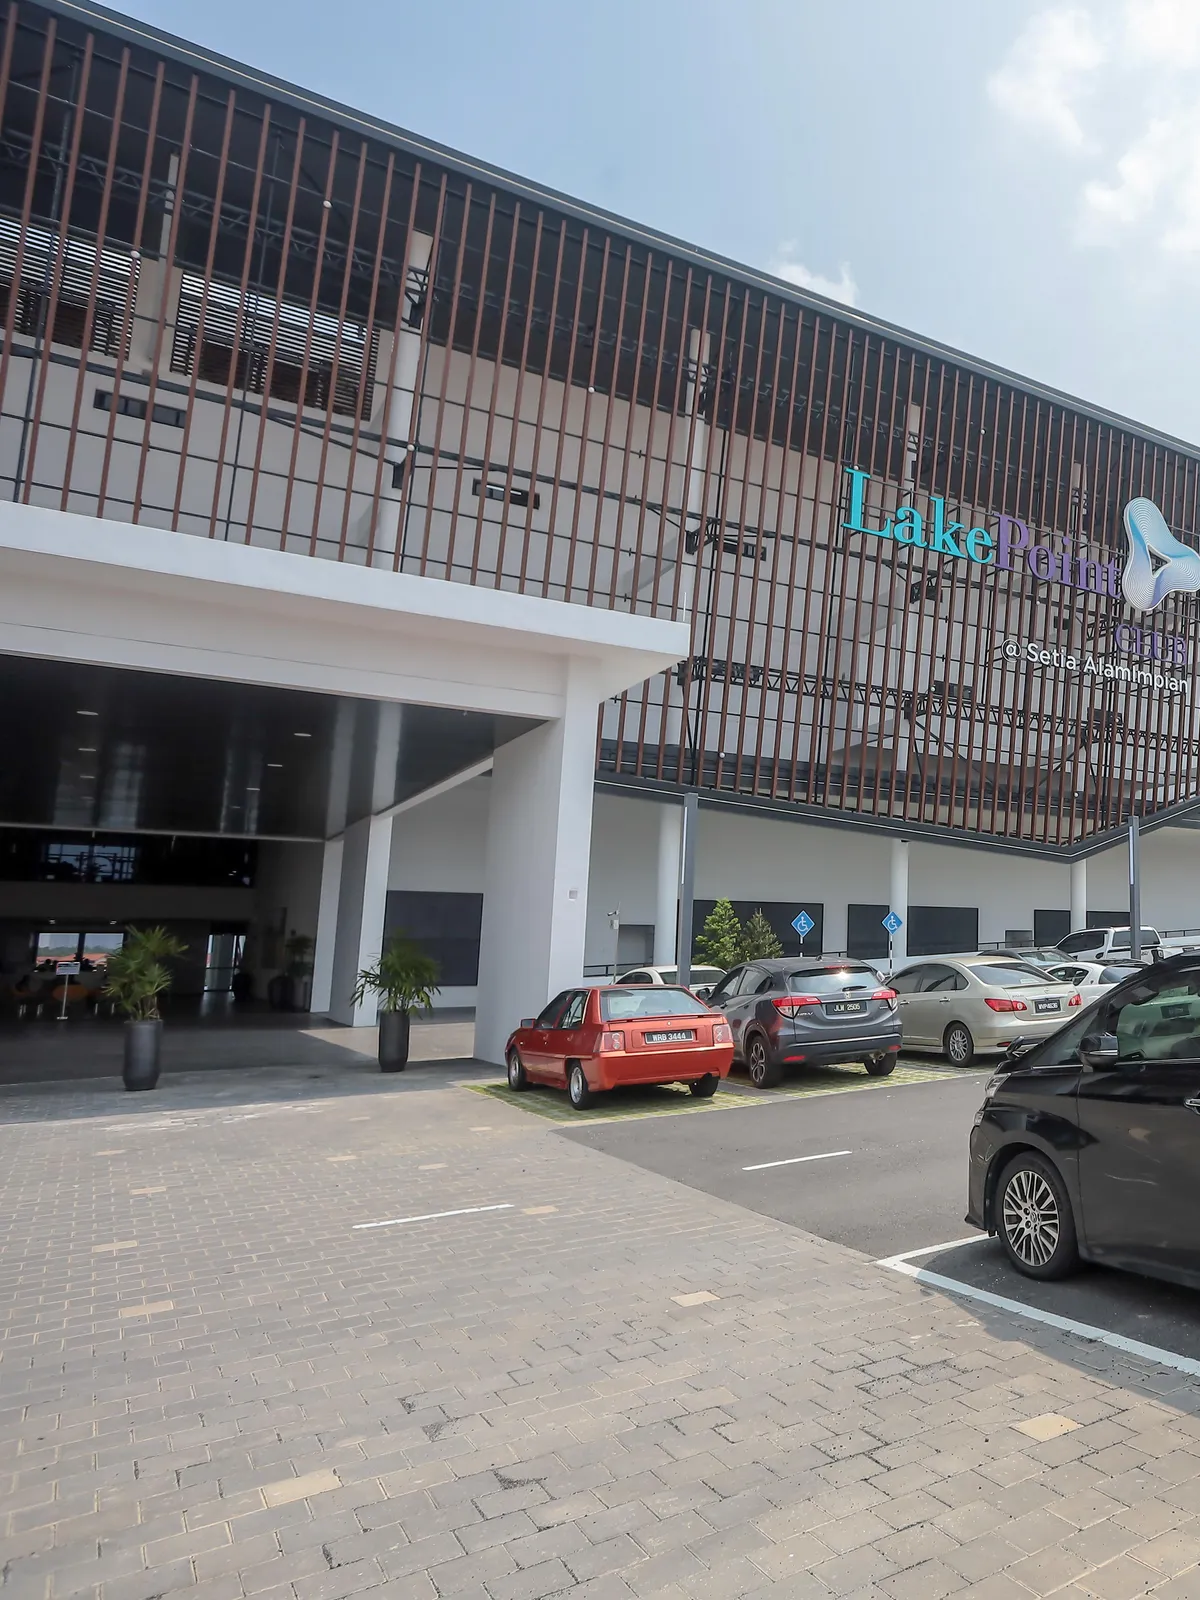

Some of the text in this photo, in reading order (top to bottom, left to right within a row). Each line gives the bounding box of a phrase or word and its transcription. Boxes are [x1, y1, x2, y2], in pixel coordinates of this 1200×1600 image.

[841, 466, 1122, 600] LakePoint
[1001, 638, 1022, 662] @
[1027, 642, 1077, 671] Setia
[1115, 623, 1187, 665] CLUB
[652, 1032, 686, 1042] WRB 3444
